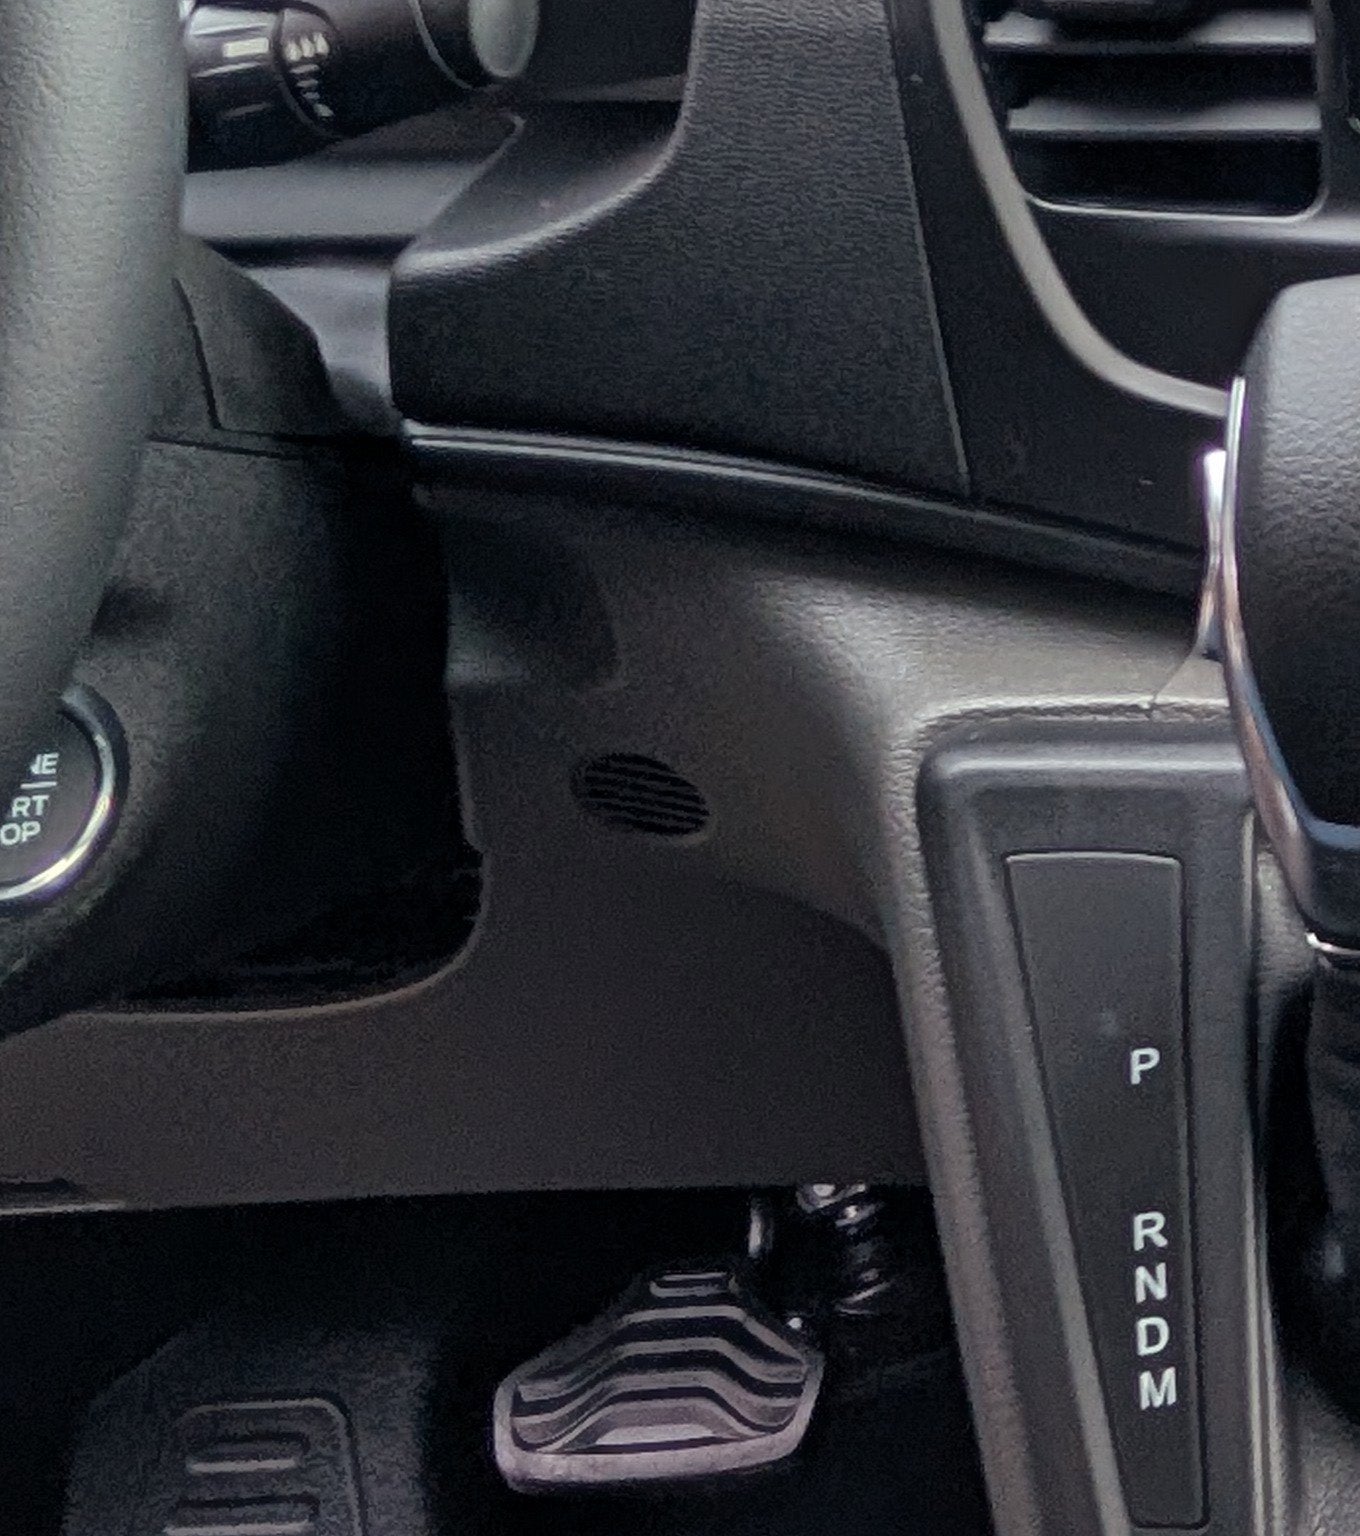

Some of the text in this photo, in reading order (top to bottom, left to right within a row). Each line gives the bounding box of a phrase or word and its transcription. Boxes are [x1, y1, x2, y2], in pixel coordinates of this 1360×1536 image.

[1129, 1047, 1161, 1085] P
[1132, 1210, 1168, 1252] R
[1134, 1263, 1168, 1303] N
[1136, 1315, 1170, 1356] D
[1139, 1367, 1178, 1411] M
